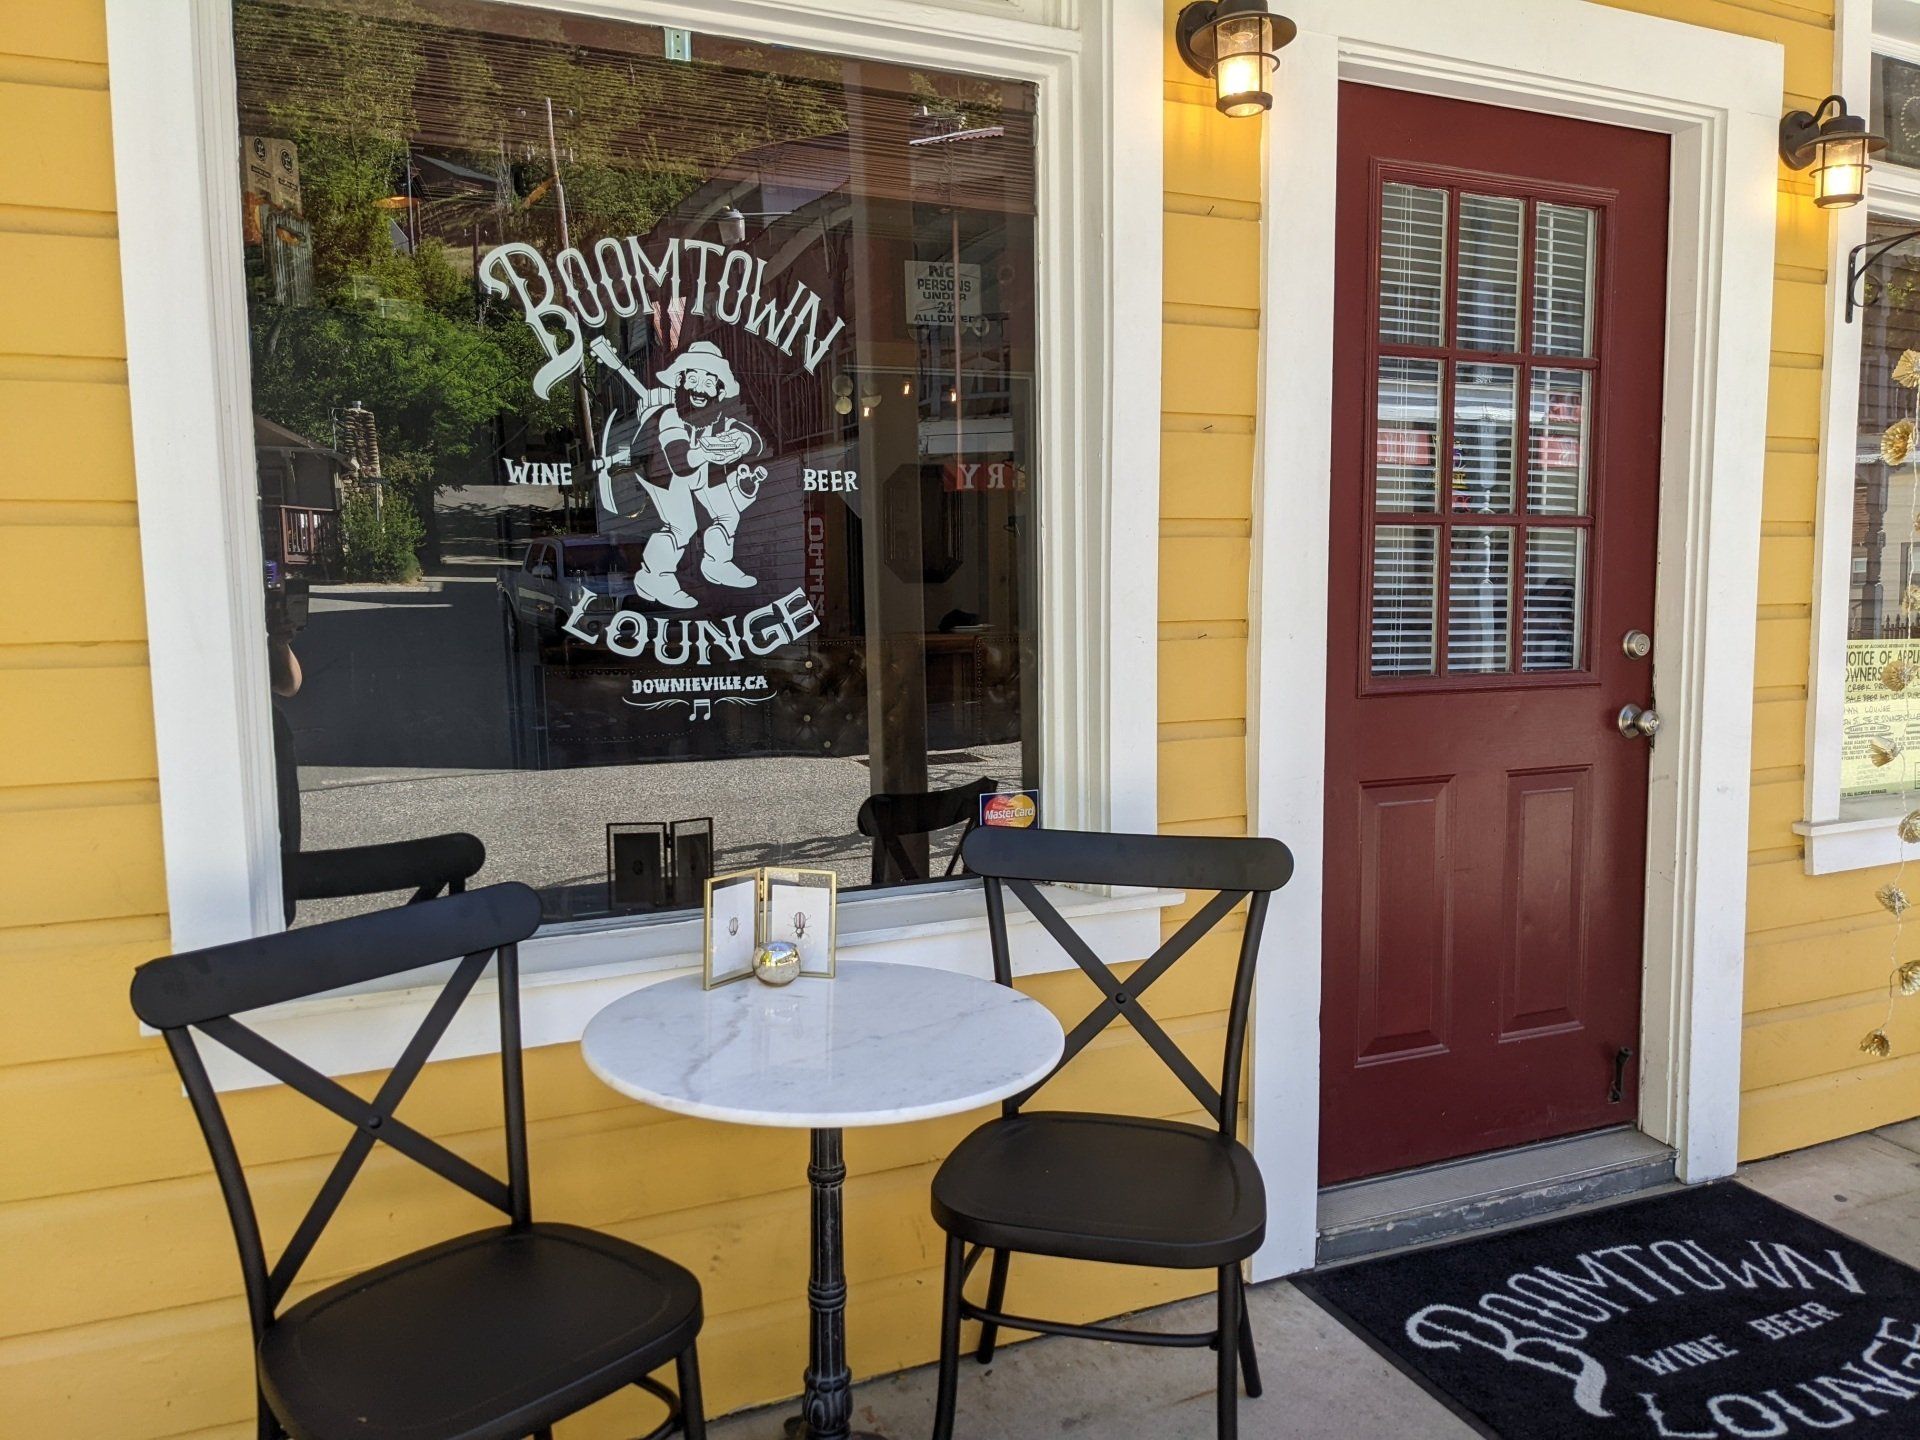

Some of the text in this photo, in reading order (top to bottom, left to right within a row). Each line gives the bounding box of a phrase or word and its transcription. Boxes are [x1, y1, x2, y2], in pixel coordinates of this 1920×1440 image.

[479, 236, 845, 400] BOOMTOWN
[502, 458, 573, 485] WINE
[802, 467, 859, 491] BEER
[562, 585, 821, 666] LOUNGE
[1879, 650, 1893, 665] OF
[985, 807, 1035, 820] MasterCard
[1405, 1239, 1867, 1418] BOOMTOWN
[1627, 1300, 1843, 1377] WINE BEER
